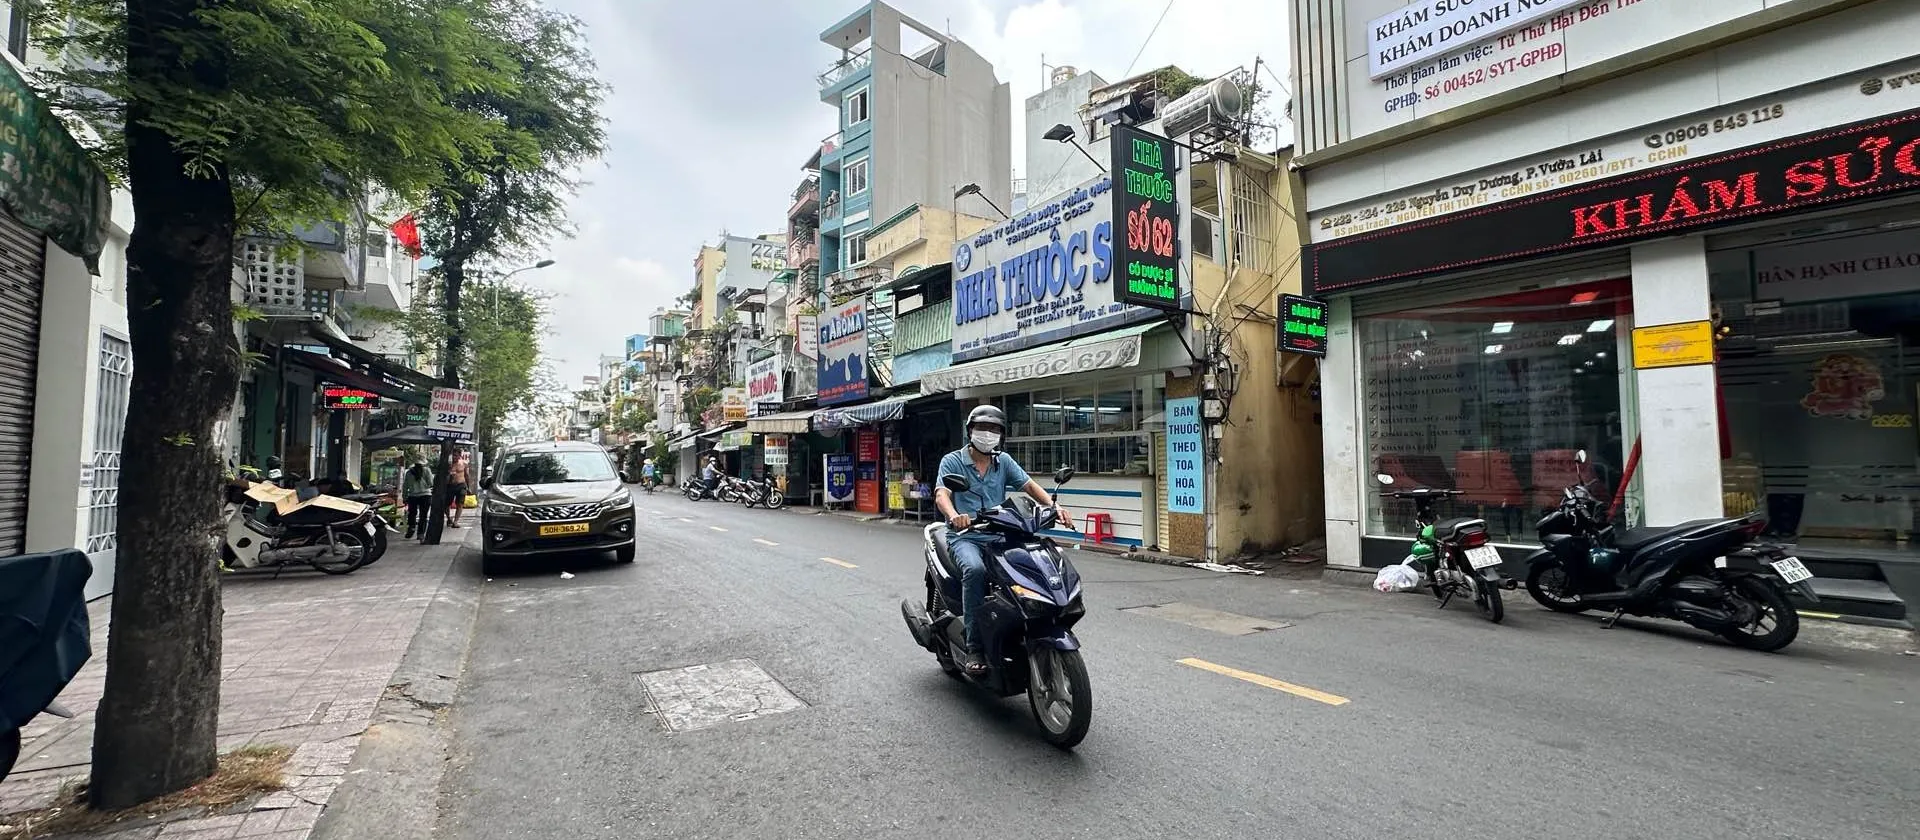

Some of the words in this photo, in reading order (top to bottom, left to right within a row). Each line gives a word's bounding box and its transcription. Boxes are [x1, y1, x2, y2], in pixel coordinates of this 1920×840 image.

[1375, 8, 1429, 41] KHÁM
[1379, 32, 1433, 66] KHÁM
[1439, 8, 1509, 43] DOANH
[1384, 74, 1407, 91] Thời
[1411, 65, 1435, 84] gian
[1439, 55, 1460, 73] làm
[1464, 44, 1494, 63] việc:
[1497, 34, 1515, 51] Từ
[1520, 22, 1546, 41] Thứ
[1550, 12, 1574, 32] Hai
[1579, 2, 1609, 22] Đến
[1384, 92, 1421, 113] GPHĐ:
[1424, 82, 1440, 100] Số
[1443, 42, 1562, 93] 00452/SYT-GPHĐ
[1666, 124, 1708, 145] 0906
[1714, 113, 1747, 132] 843
[1132, 138, 1162, 170] NHÀ
[1648, 145, 1688, 162] CCHN
[1125, 168, 1172, 203] THUỐC
[1452, 182, 1476, 198] Duy
[1479, 171, 1523, 191] Dương,
[1571, 170, 1760, 240] KHÁM
[994, 227, 1004, 240] TY
[1128, 200, 1151, 253] SỐ
[1152, 216, 1172, 258] 62
[1129, 262, 1141, 277] CÓ
[1141, 266, 1164, 283] DƯỢC
[1801, 260, 1856, 280] HẠNH
[1128, 279, 1158, 297] HƯỚNG
[1016, 302, 1049, 319] CHUYÊN
[1050, 296, 1069, 312] BÁN
[948, 371, 984, 389] NHÀ
[991, 356, 1067, 382] THUỐC
[1077, 350, 1112, 368] 62
[434, 390, 454, 400] CƠM
[433, 402, 454, 413] CHÂU
[1174, 403, 1193, 417] BÁN
[437, 413, 467, 424] 287
[1169, 421, 1200, 435] THUỐC
[1172, 442, 1196, 453] THEO
[1176, 459, 1194, 470] TOA
[833, 472, 846, 486] 59
